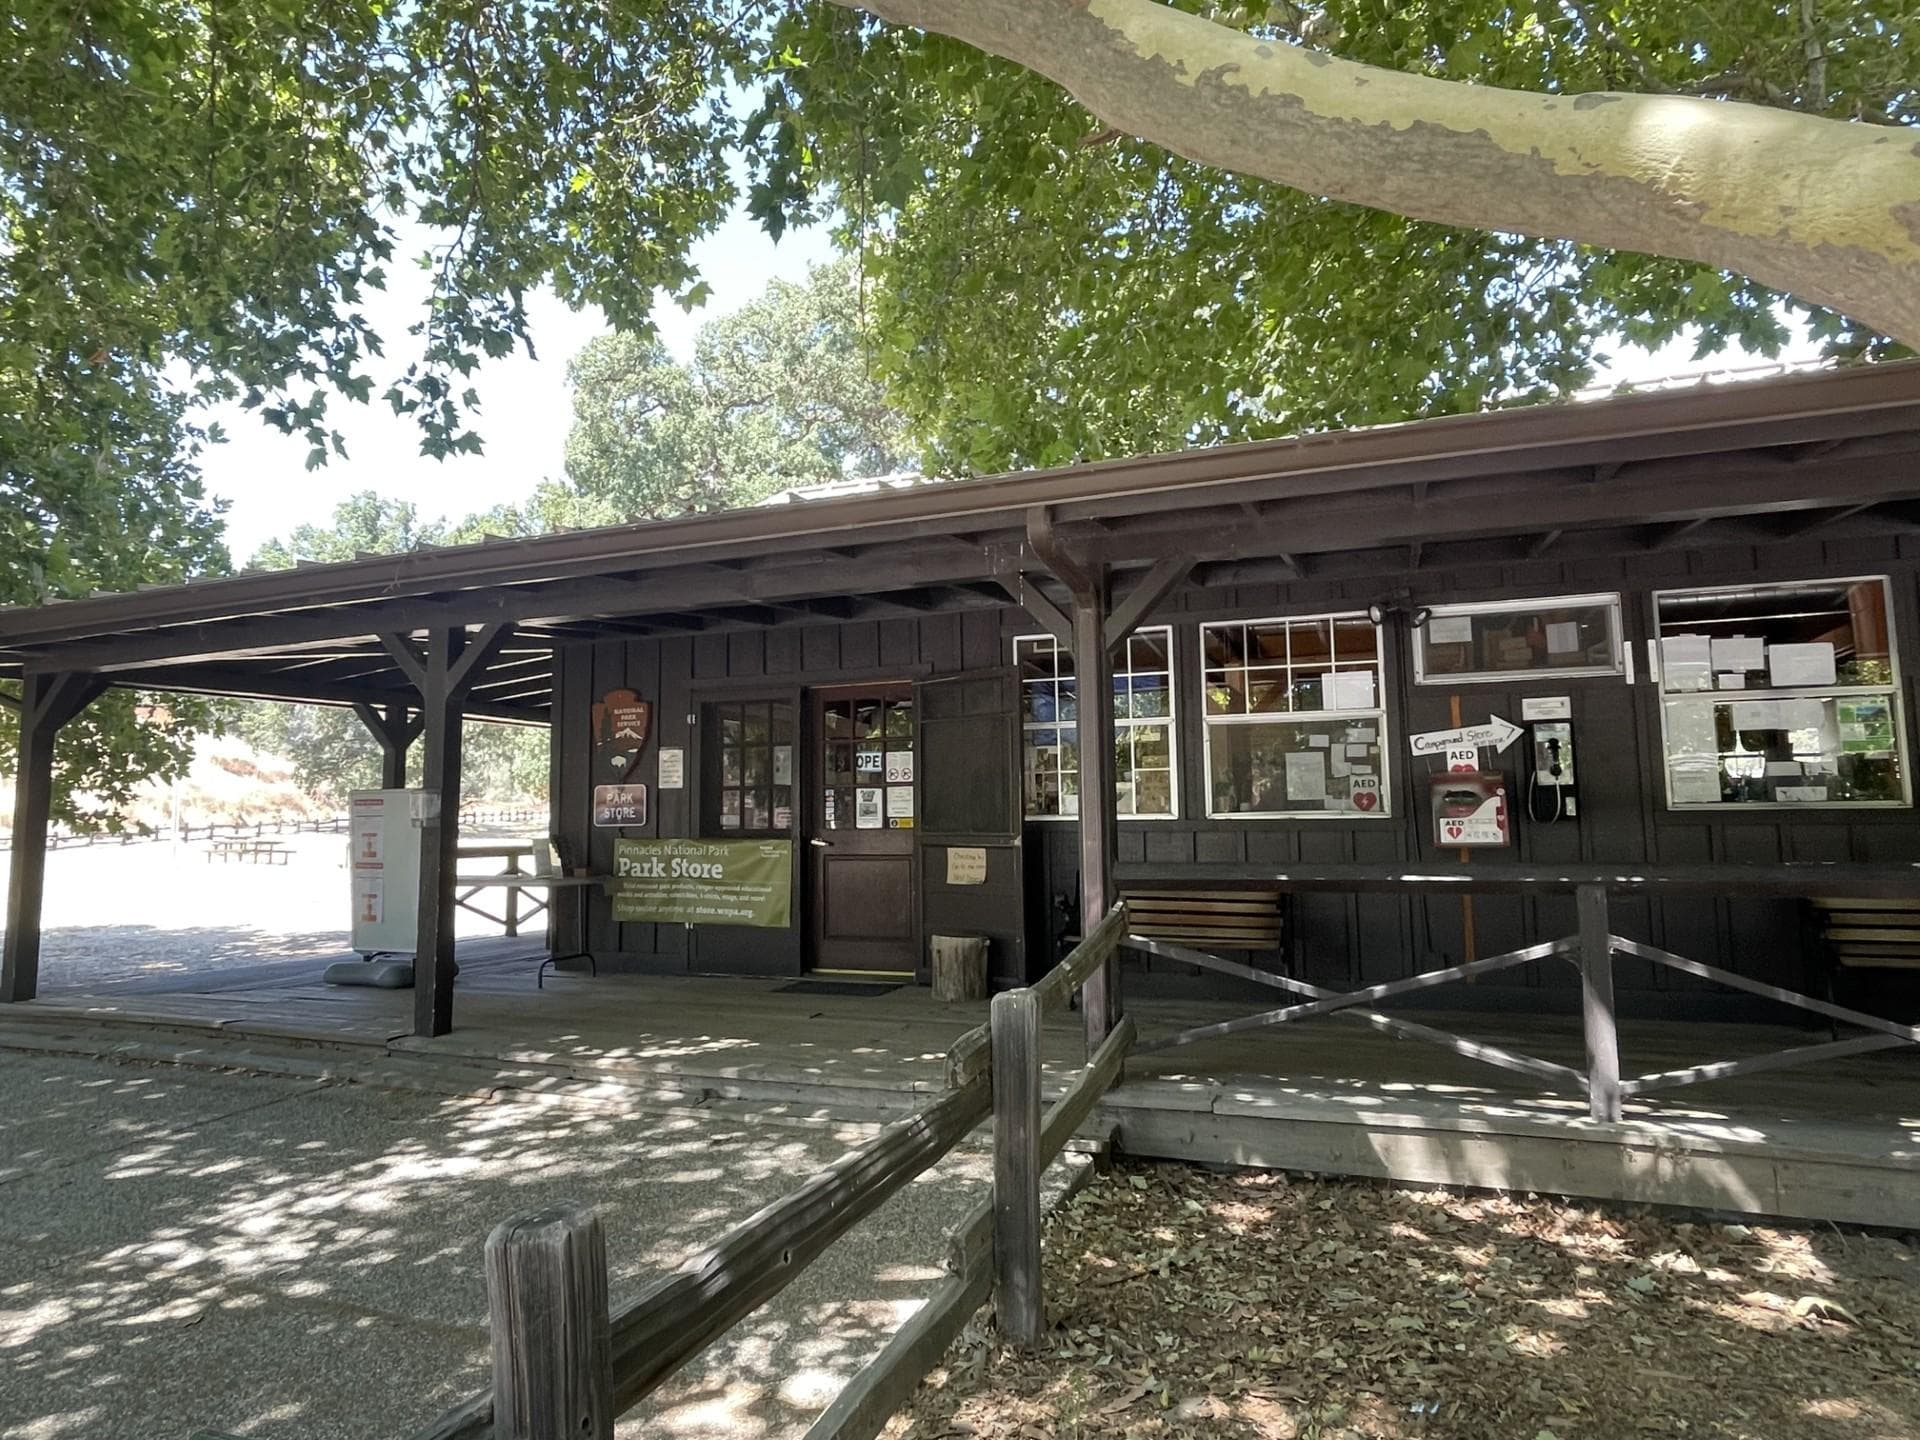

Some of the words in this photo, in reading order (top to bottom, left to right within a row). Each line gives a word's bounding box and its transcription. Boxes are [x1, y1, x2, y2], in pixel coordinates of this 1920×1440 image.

[617, 720, 641, 728] SERVICE
[1466, 728, 1493, 742] Store
[1450, 750, 1475, 761] AED
[856, 754, 882, 769] OPE
[1353, 779, 1376, 788] AED
[606, 794, 633, 805] PARK
[604, 808, 636, 819] STORE
[618, 845, 661, 856] Pinnacles
[664, 845, 706, 857] National
[708, 846, 730, 857] Park
[618, 857, 667, 877] Park
[671, 858, 724, 879] Store
